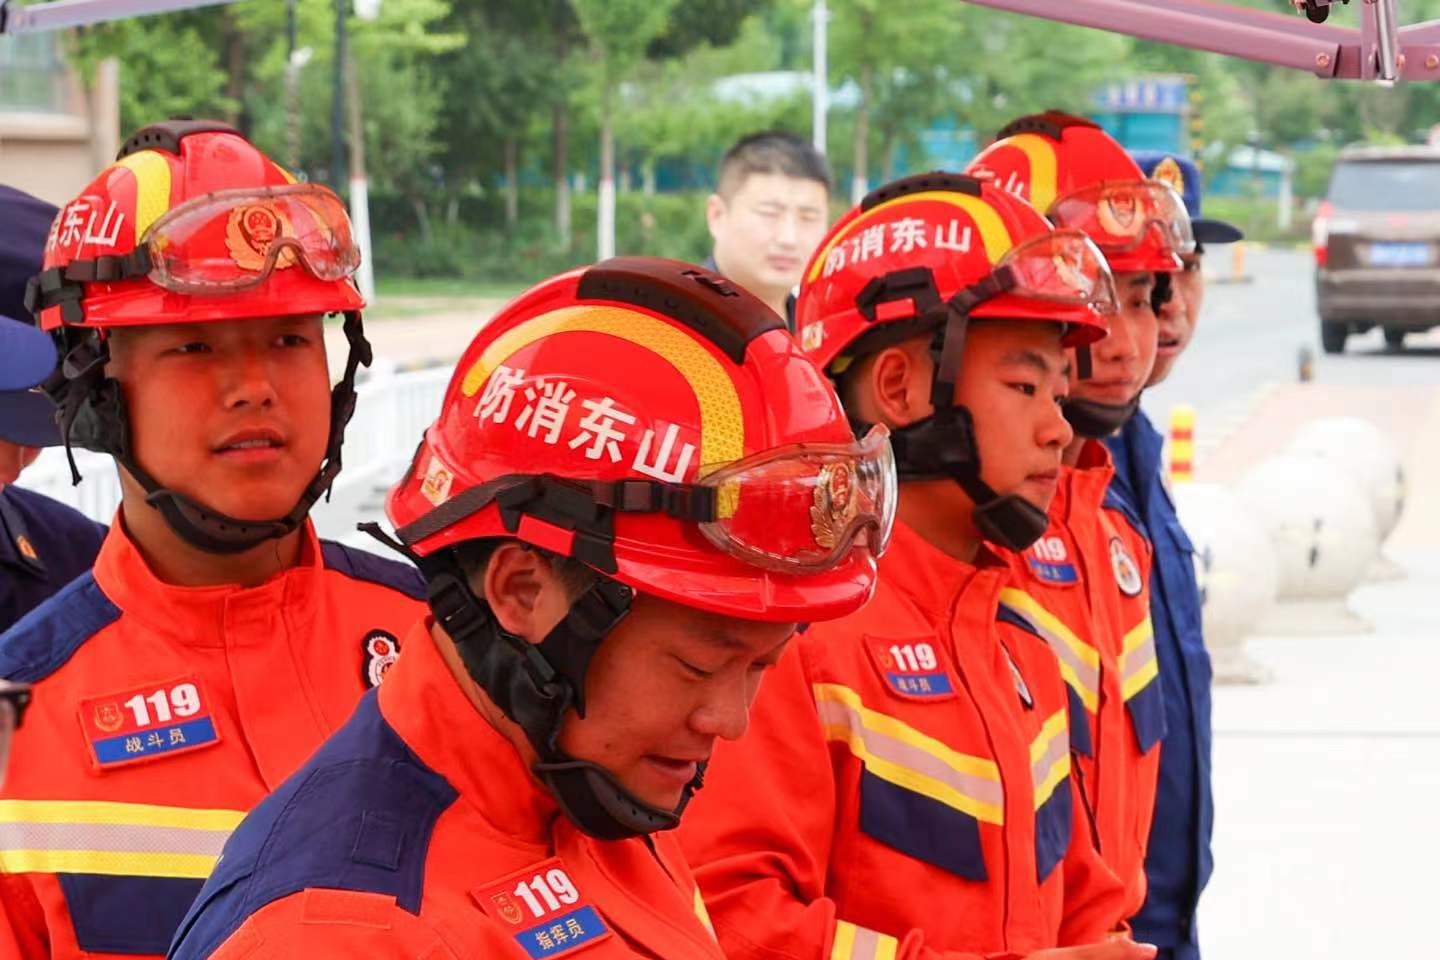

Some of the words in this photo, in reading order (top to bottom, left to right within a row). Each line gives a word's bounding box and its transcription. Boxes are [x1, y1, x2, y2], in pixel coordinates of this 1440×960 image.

[889, 642, 937, 672] 119
[124, 683, 201, 727] 119
[125, 728, 187, 753] 战斗员
[513, 868, 580, 918] 119
[535, 918, 585, 950] 指挥员
